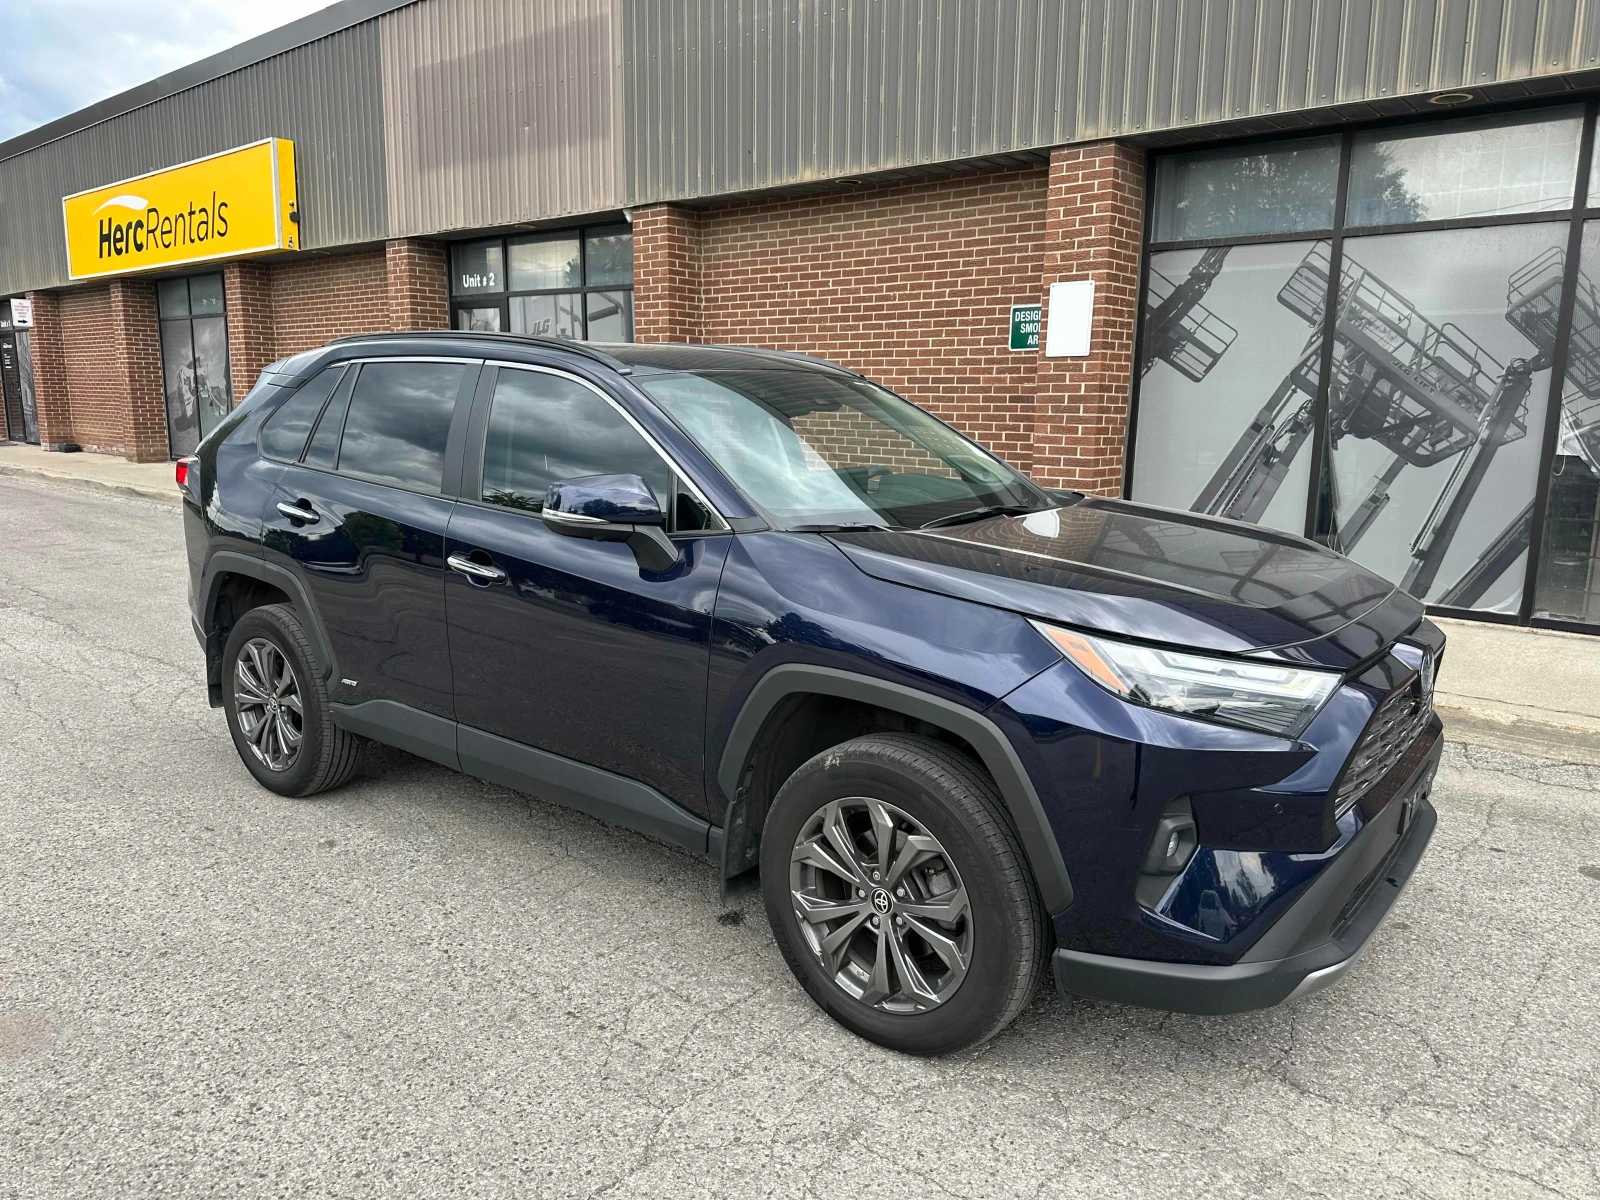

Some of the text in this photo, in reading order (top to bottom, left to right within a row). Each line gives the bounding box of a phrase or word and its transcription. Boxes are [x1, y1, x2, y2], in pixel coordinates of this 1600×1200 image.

[462, 272, 496, 288] Unit # 2
[530, 316, 552, 336] JLG
[1027, 334, 1039, 346] AR
[1391, 360, 1437, 395] JLG LIFT
